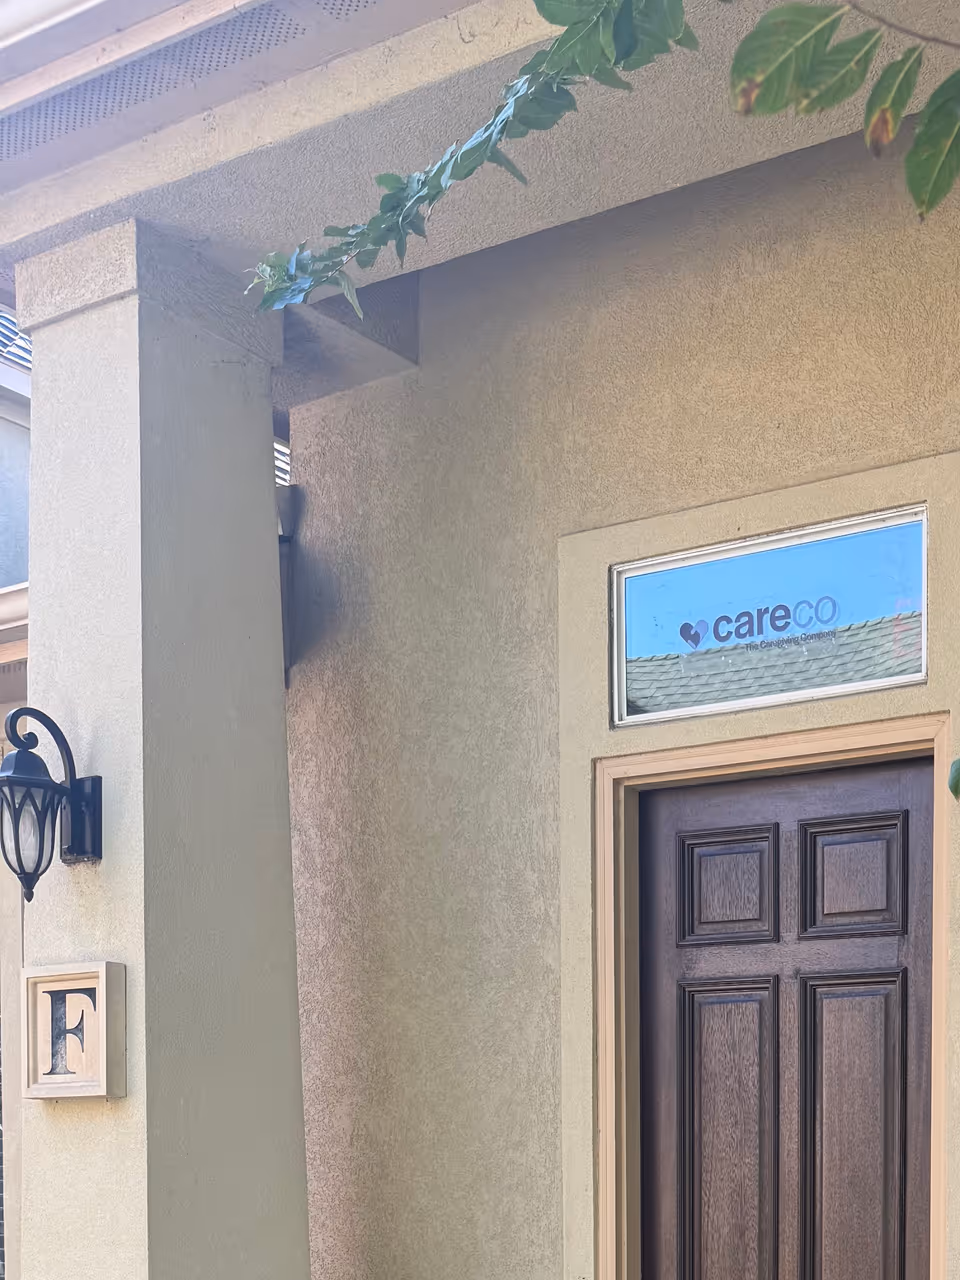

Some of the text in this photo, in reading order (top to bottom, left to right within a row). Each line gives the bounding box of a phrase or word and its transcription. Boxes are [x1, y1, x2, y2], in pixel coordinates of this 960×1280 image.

[713, 595, 837, 643] careco
[745, 630, 837, 652] The Caregiving Company
[42, 987, 97, 1076] F
